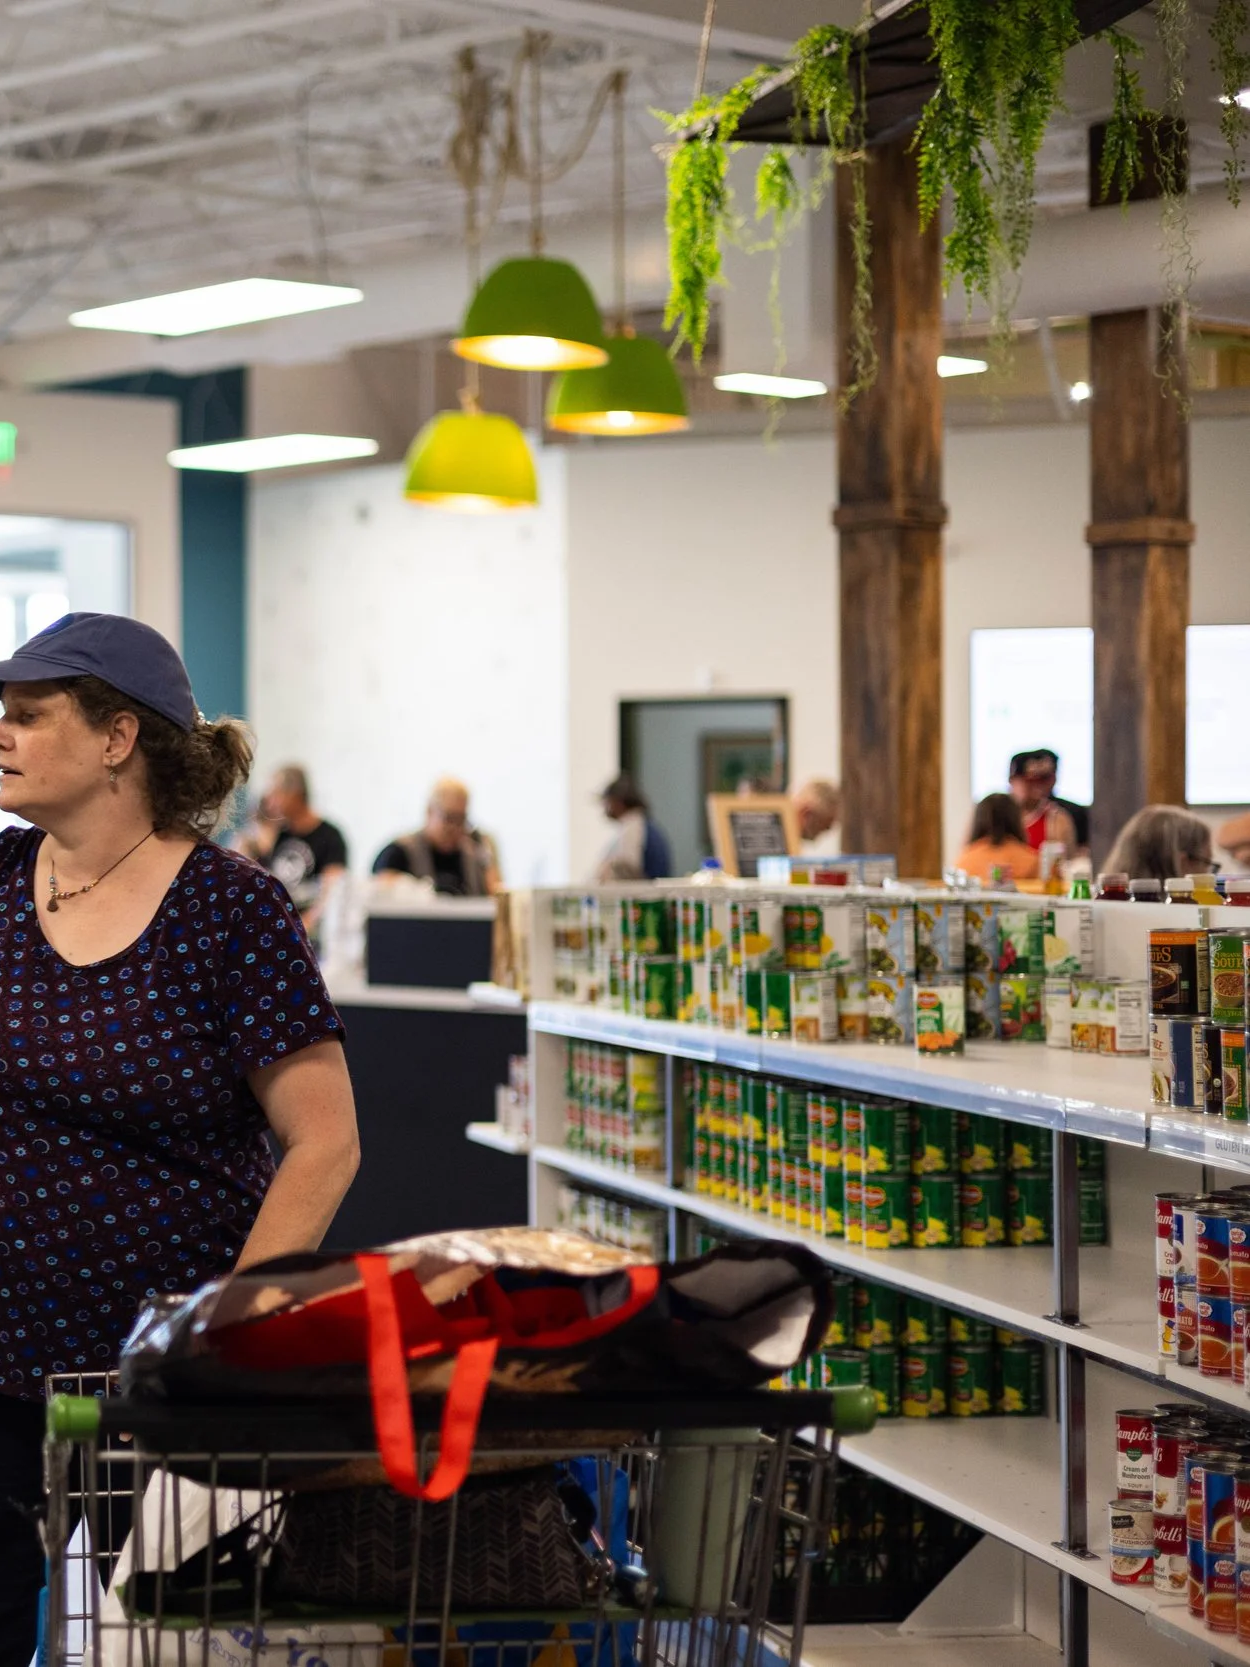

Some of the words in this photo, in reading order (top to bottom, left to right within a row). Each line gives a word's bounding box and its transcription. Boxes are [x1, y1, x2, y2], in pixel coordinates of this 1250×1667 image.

[1215, 1138, 1240, 1154] GLUTEN
[1123, 1465, 1141, 1473] Cream
[1141, 1465, 1148, 1473] of
[1121, 1472, 1151, 1480] Mushroom
